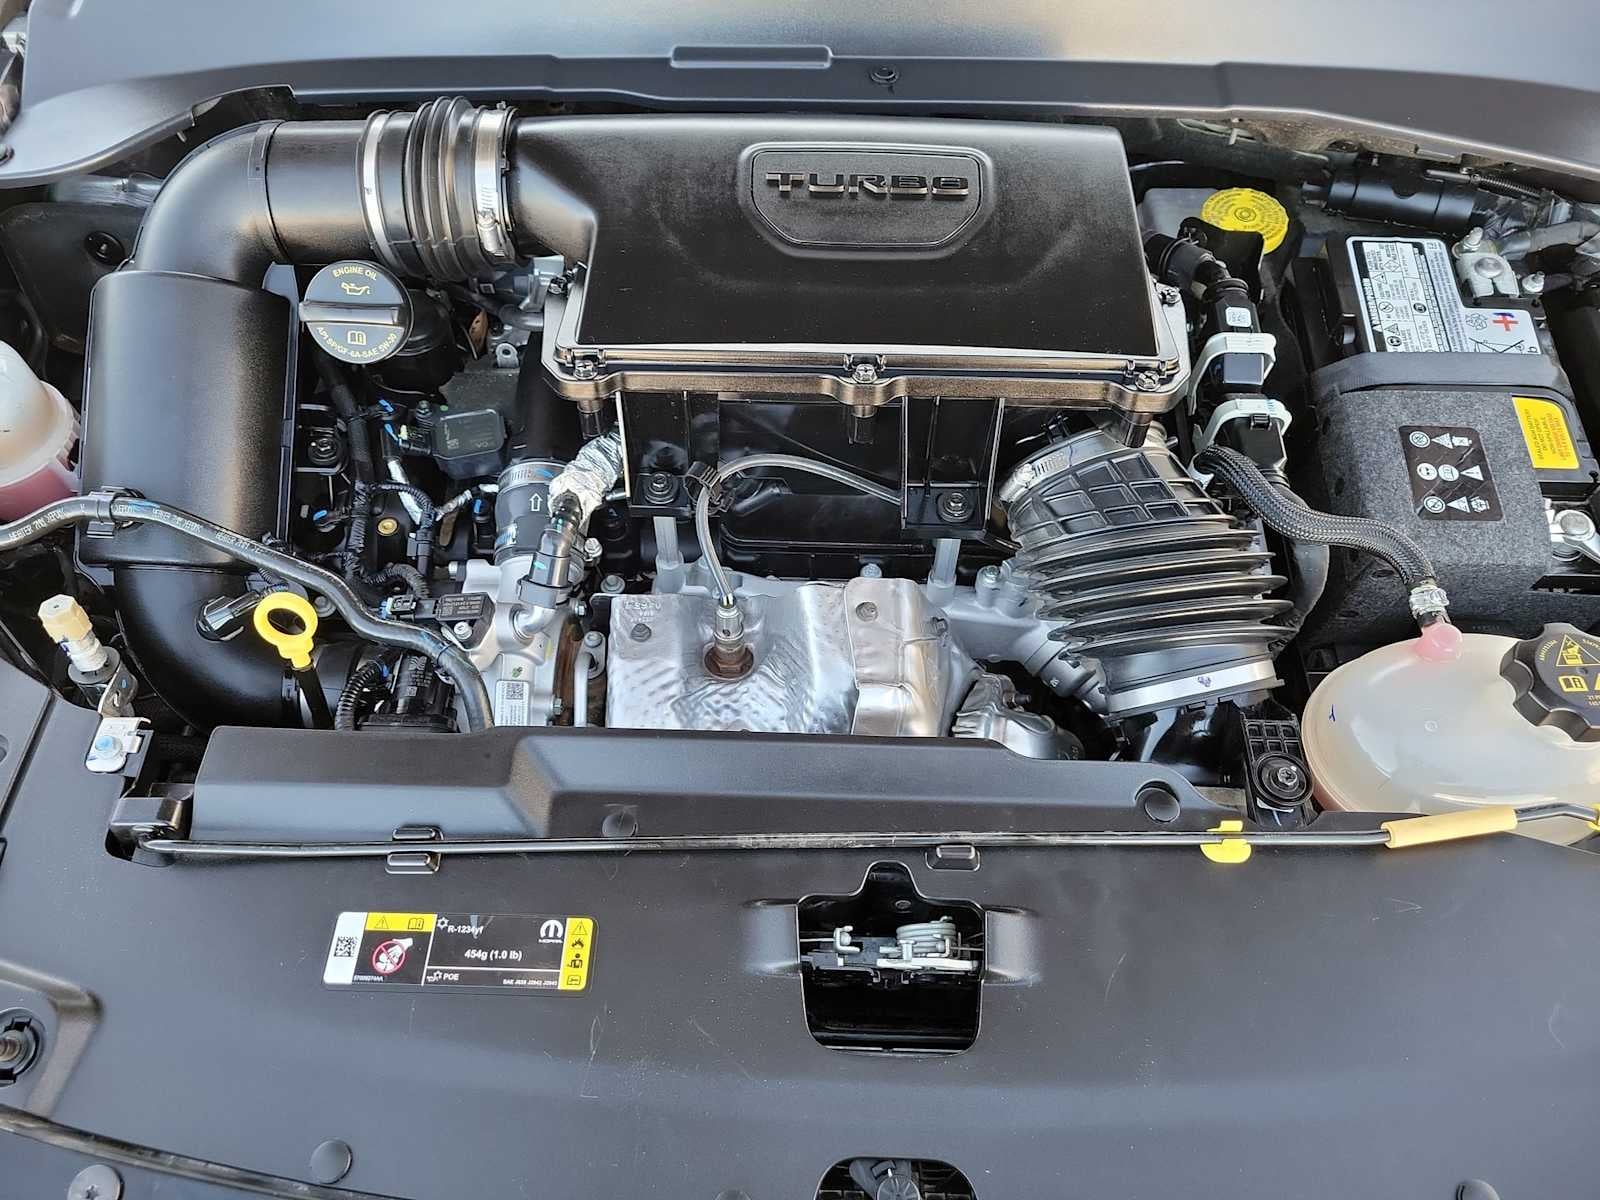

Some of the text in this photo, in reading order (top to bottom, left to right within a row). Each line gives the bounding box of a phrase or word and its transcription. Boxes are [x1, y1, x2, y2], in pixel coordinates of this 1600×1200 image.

[766, 172, 969, 197] TURBO
[332, 265, 378, 281] ENGINE OIL
[317, 326, 329, 341] API
[447, 925, 484, 935] R-1234yf
[464, 949, 523, 961] 454g (1.0 lb)
[443, 972, 459, 981] POE
